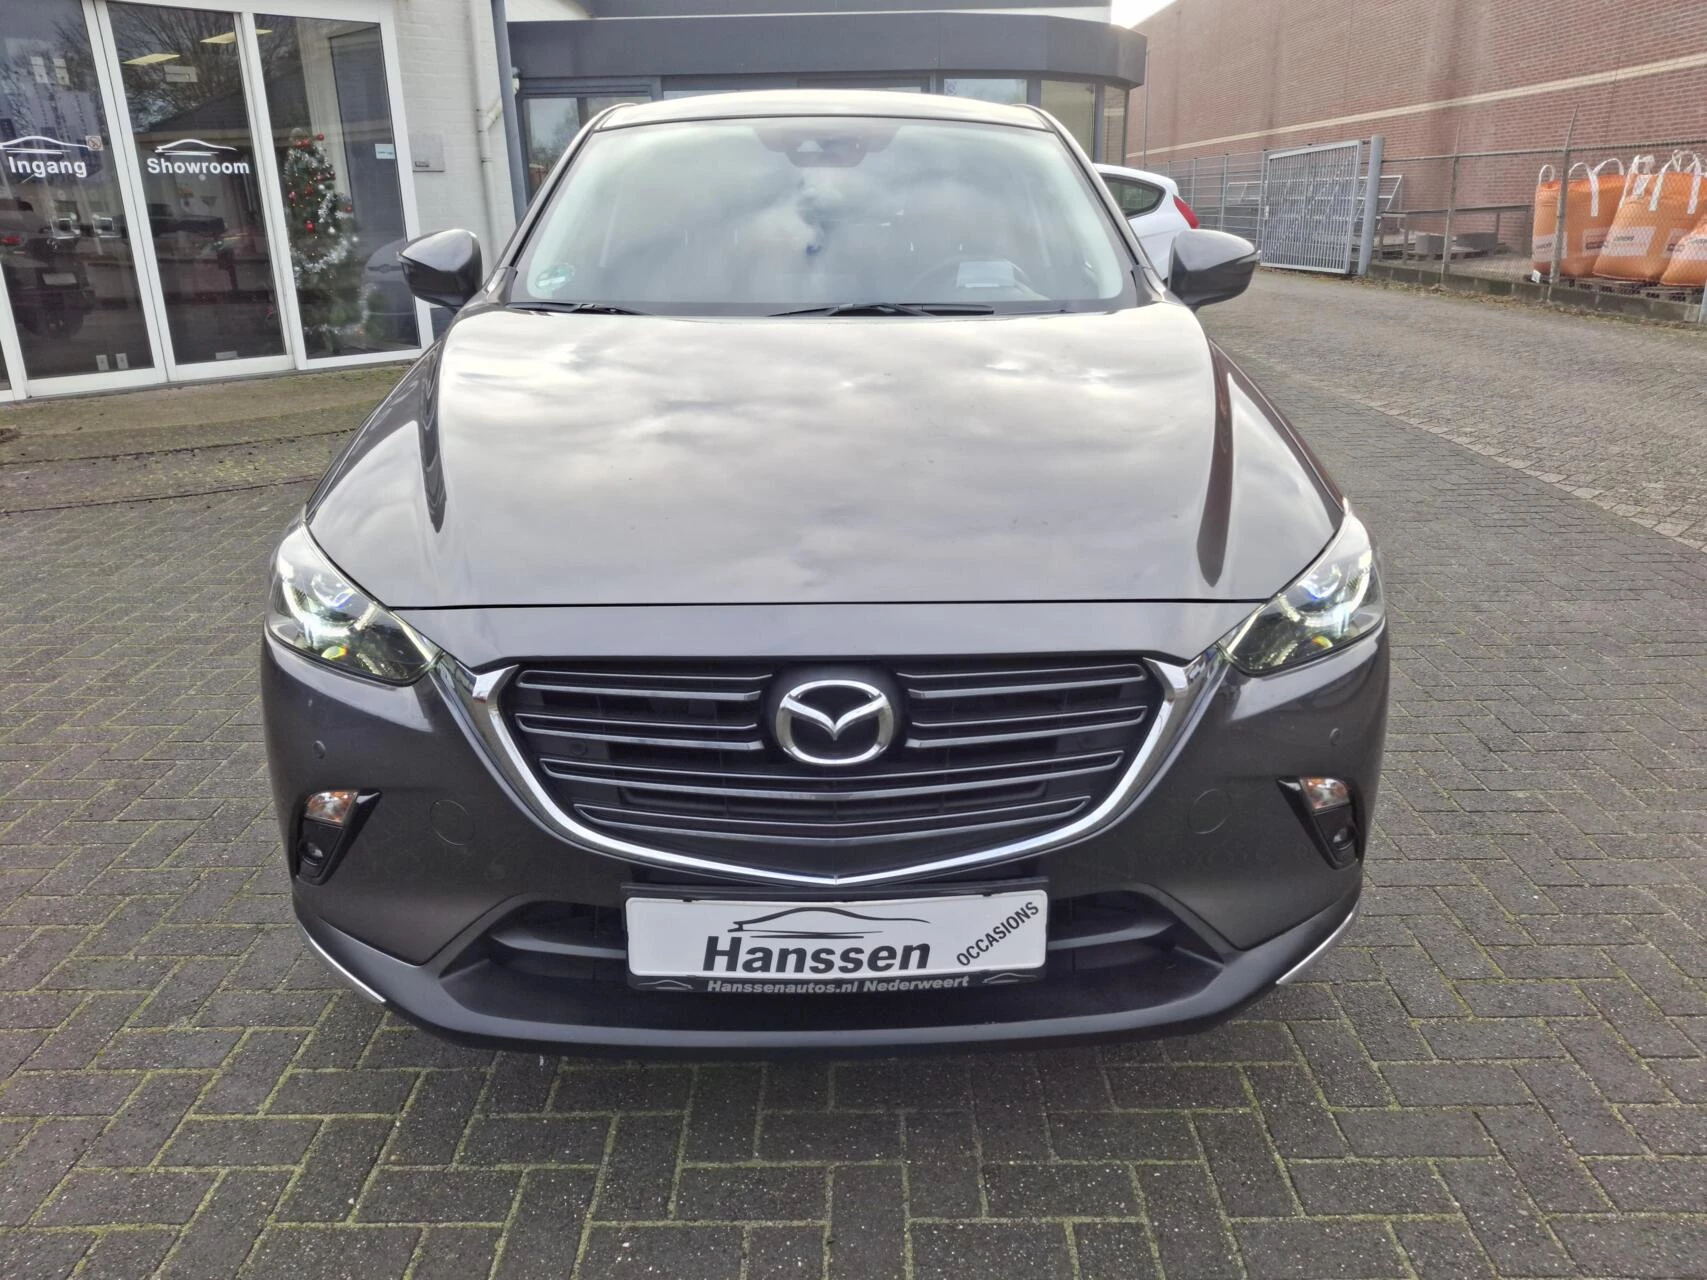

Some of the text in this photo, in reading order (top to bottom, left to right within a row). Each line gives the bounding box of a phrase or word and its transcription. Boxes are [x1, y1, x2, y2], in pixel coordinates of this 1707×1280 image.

[9, 156, 87, 178] Ingang
[148, 157, 249, 176] Showroom
[957, 901, 1040, 966] OCCASIONS
[703, 936, 931, 973] Hanssen
[707, 976, 970, 994] Hanssenautos.nl Nederweert
